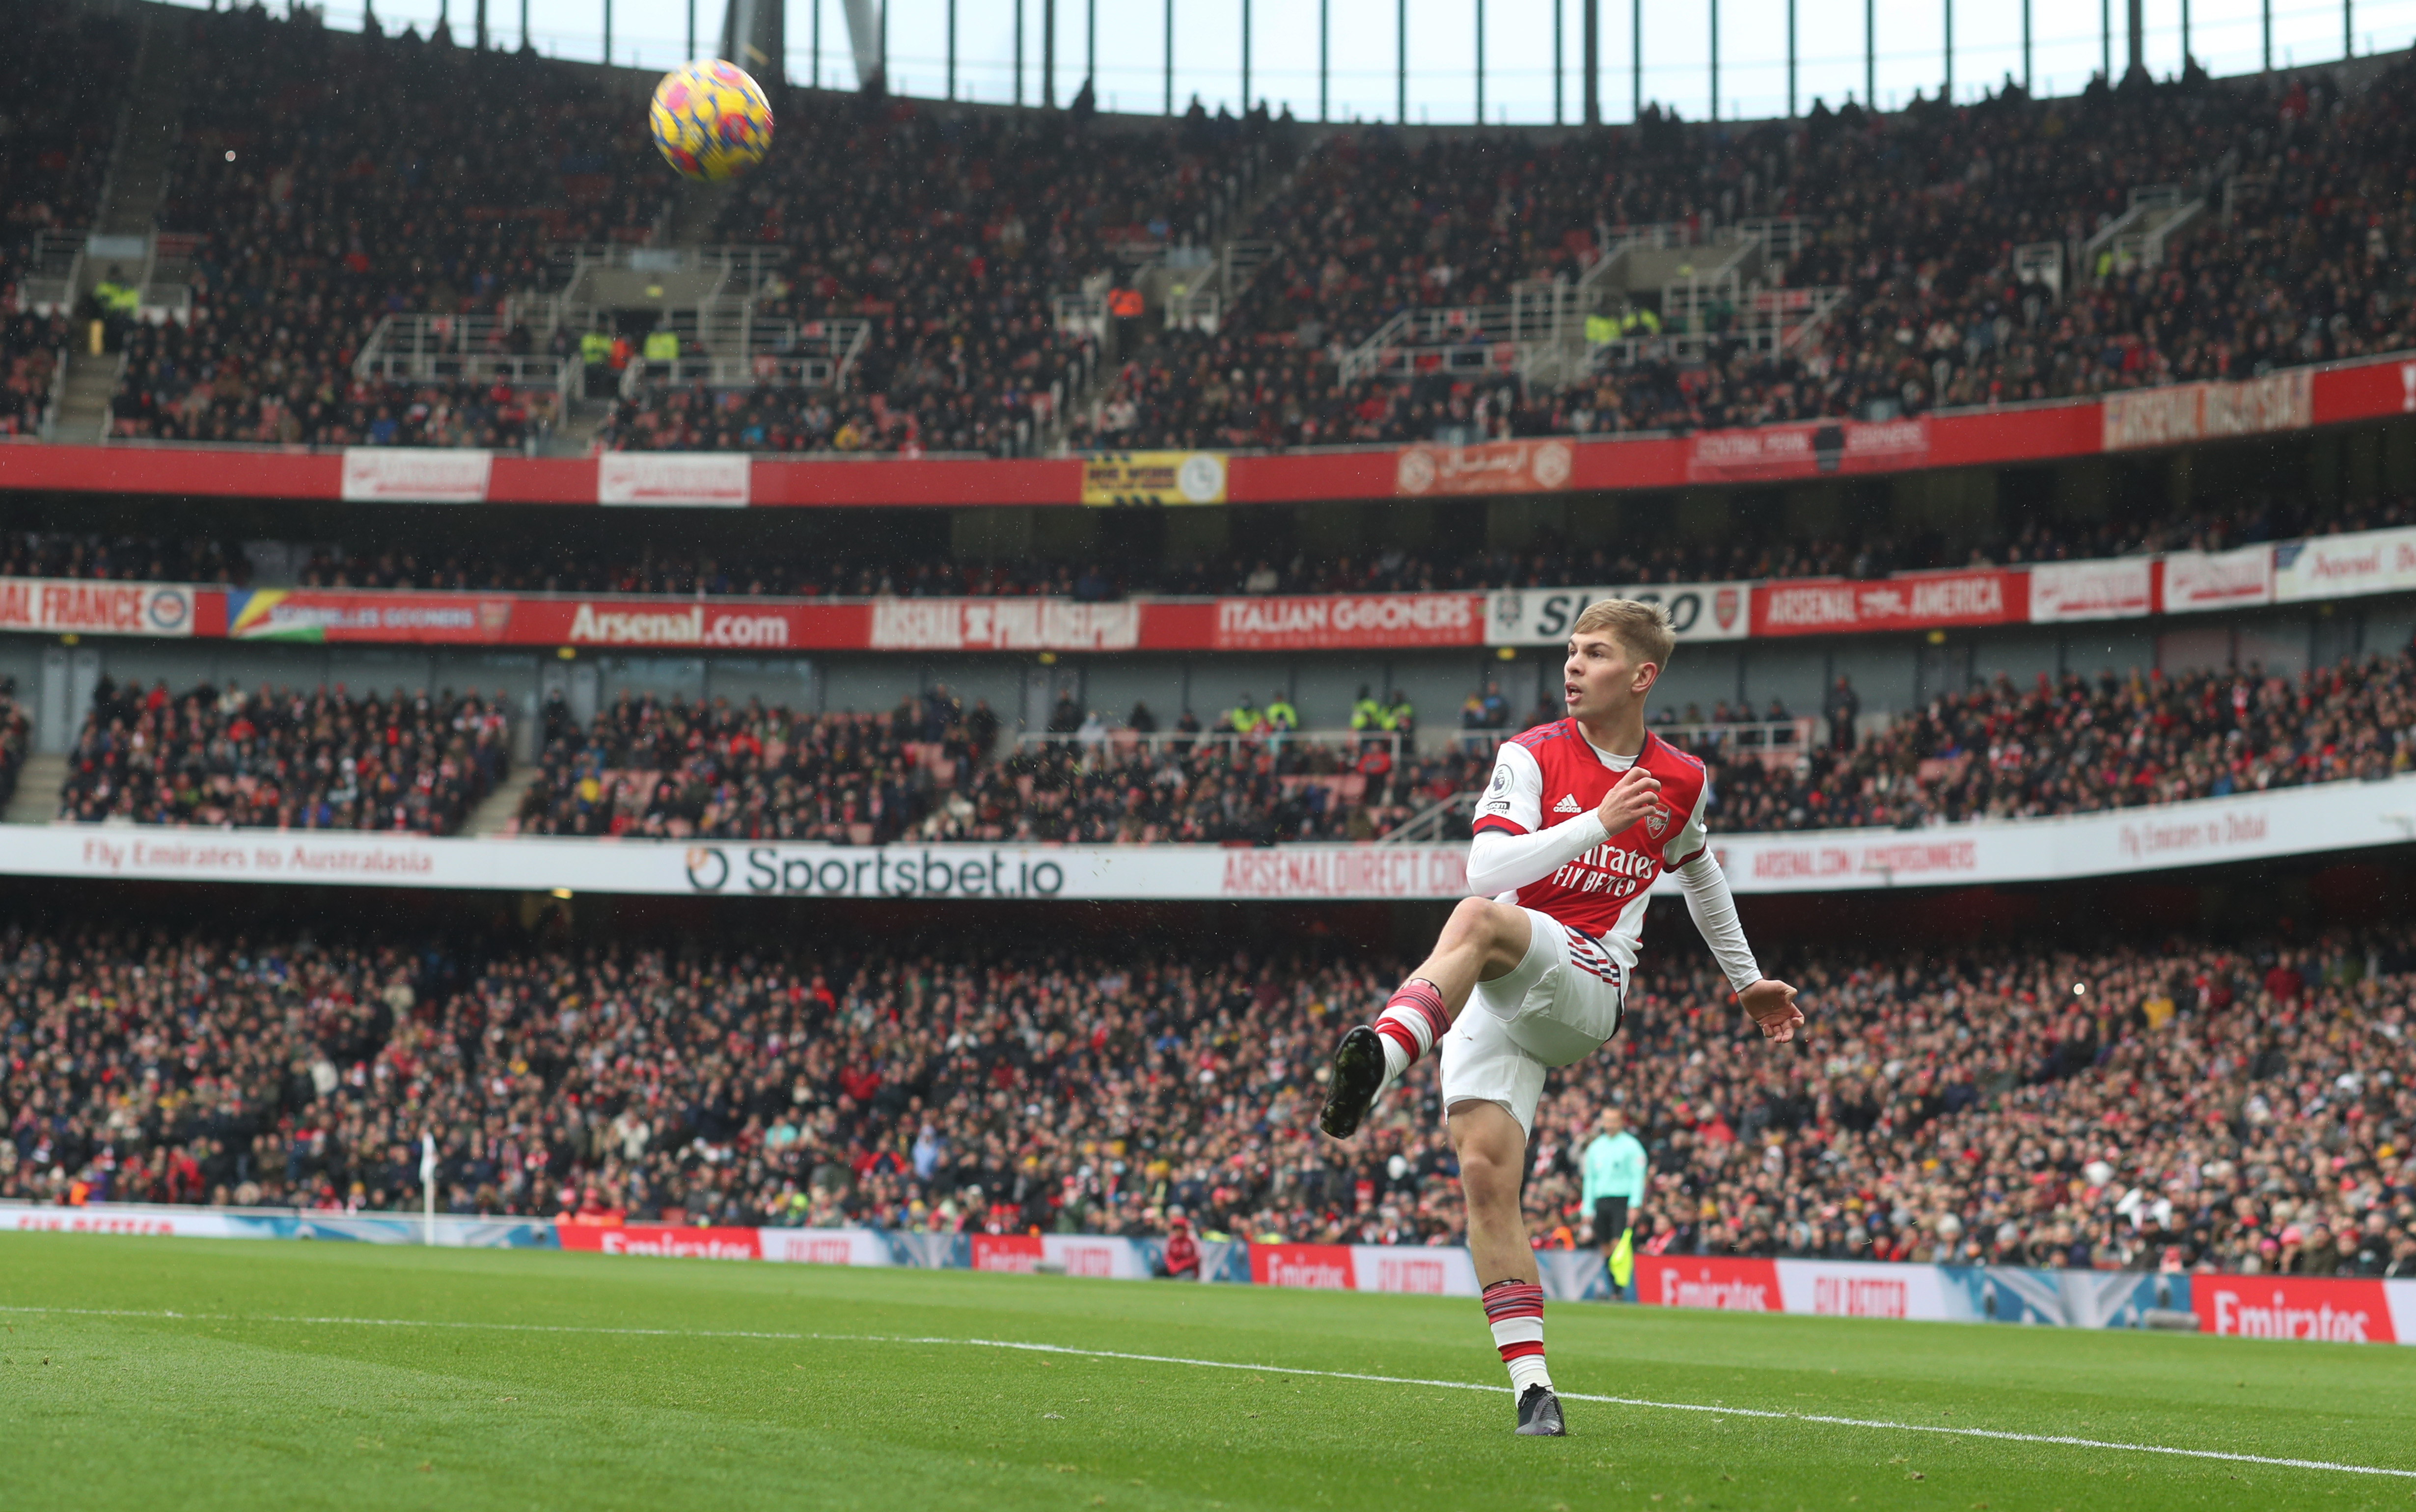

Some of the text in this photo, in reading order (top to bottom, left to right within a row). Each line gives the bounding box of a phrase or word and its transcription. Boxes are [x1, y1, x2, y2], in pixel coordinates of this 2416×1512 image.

[43, 587, 144, 629] FRANCE
[1220, 596, 1471, 633] ITALIAN GOONERS
[1769, 577, 2004, 624] ARSENAL AMERICA
[570, 603, 788, 646] Arsenal.com
[84, 837, 125, 873] Fly
[133, 841, 246, 870] Emirates
[256, 846, 282, 870] to
[747, 847, 1064, 895] Sportsbet.io
[1552, 864, 1586, 889] FLY
[601, 1232, 752, 1259] Emirates
[1267, 1253, 1346, 1289] Emirates
[1661, 1268, 1768, 1312] Emirates
[2214, 1290, 2370, 1343] Emirates
